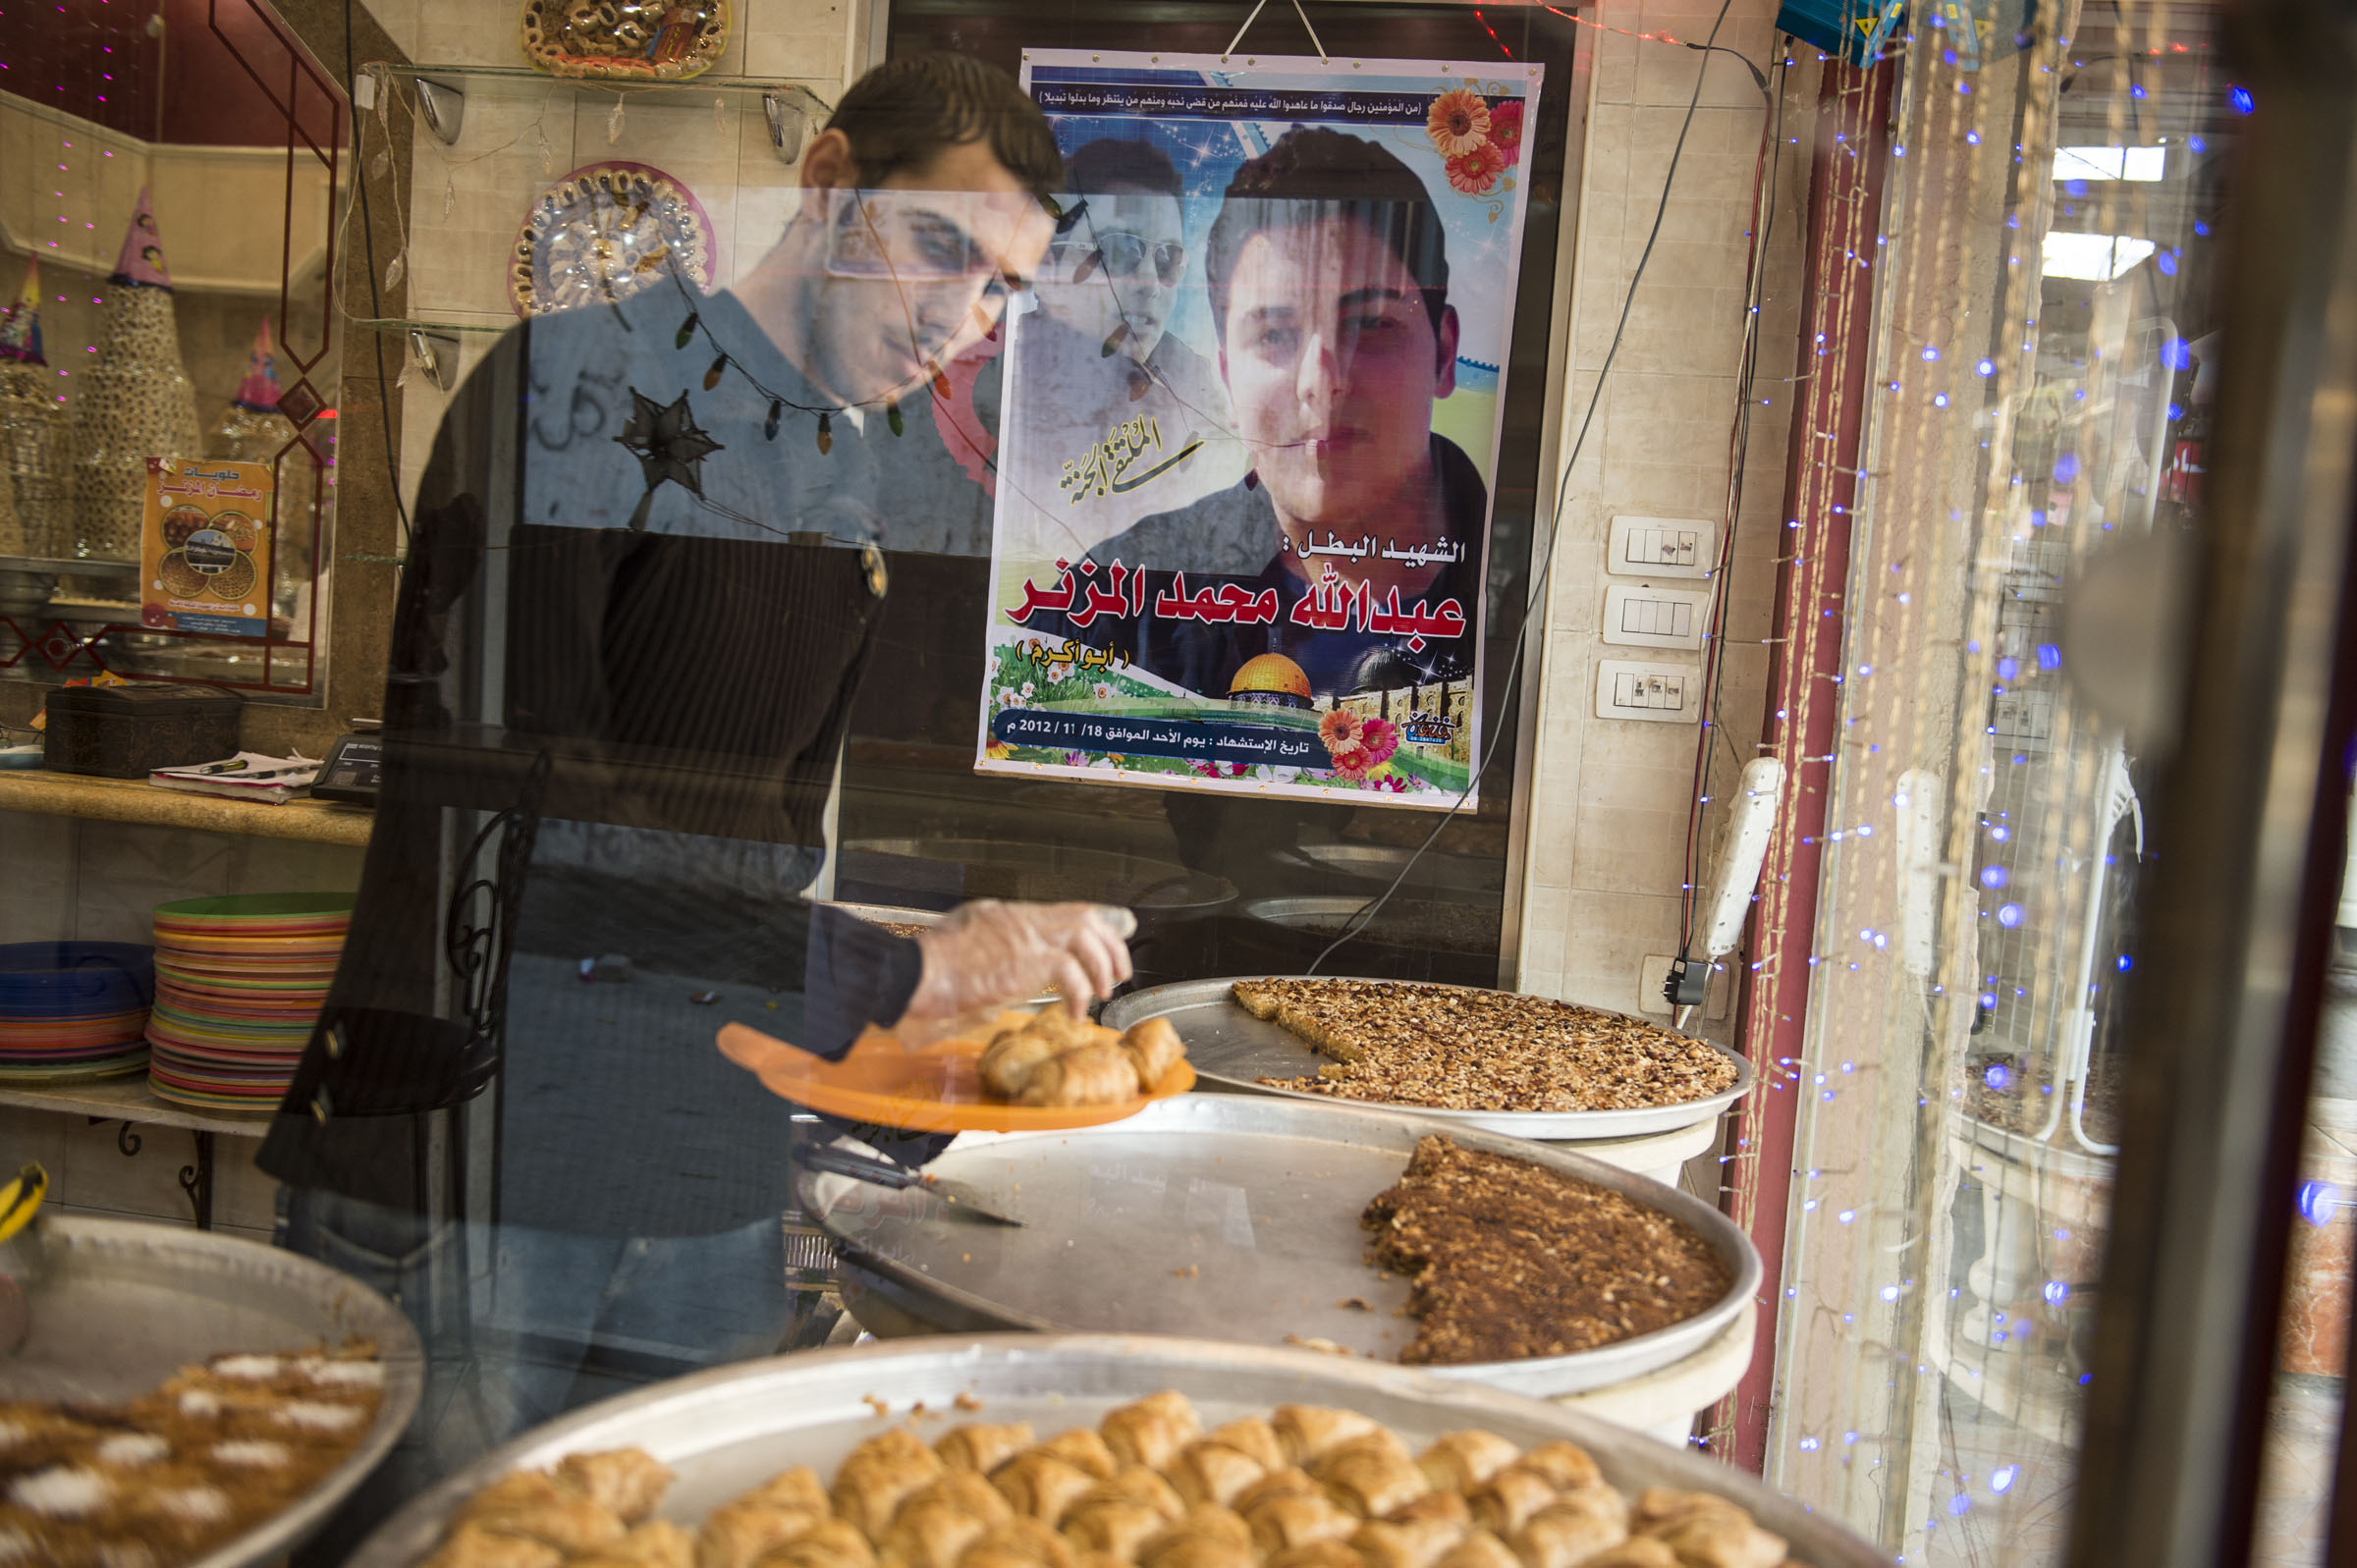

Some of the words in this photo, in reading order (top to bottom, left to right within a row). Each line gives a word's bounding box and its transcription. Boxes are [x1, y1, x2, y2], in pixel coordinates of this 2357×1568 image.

[1125, 94, 1138, 107] من
[1207, 97, 1220, 110] من
[1268, 97, 1281, 109] الله
[1283, 99, 1308, 113] عاهدوا
[1310, 100, 1319, 110] ما
[1320, 99, 1345, 113] صدقوا
[1346, 101, 1366, 114] رجال
[1296, 529, 1377, 564] البطل
[1381, 535, 1466, 568] الشهيد
[1155, 569, 1280, 624] محمد
[1019, 719, 1052, 732] 2012
[1105, 727, 1150, 742] الموافق
[1152, 728, 1181, 744] الأحد
[1182, 735, 1206, 749] يوم
[1279, 740, 1310, 755] تاريخ
